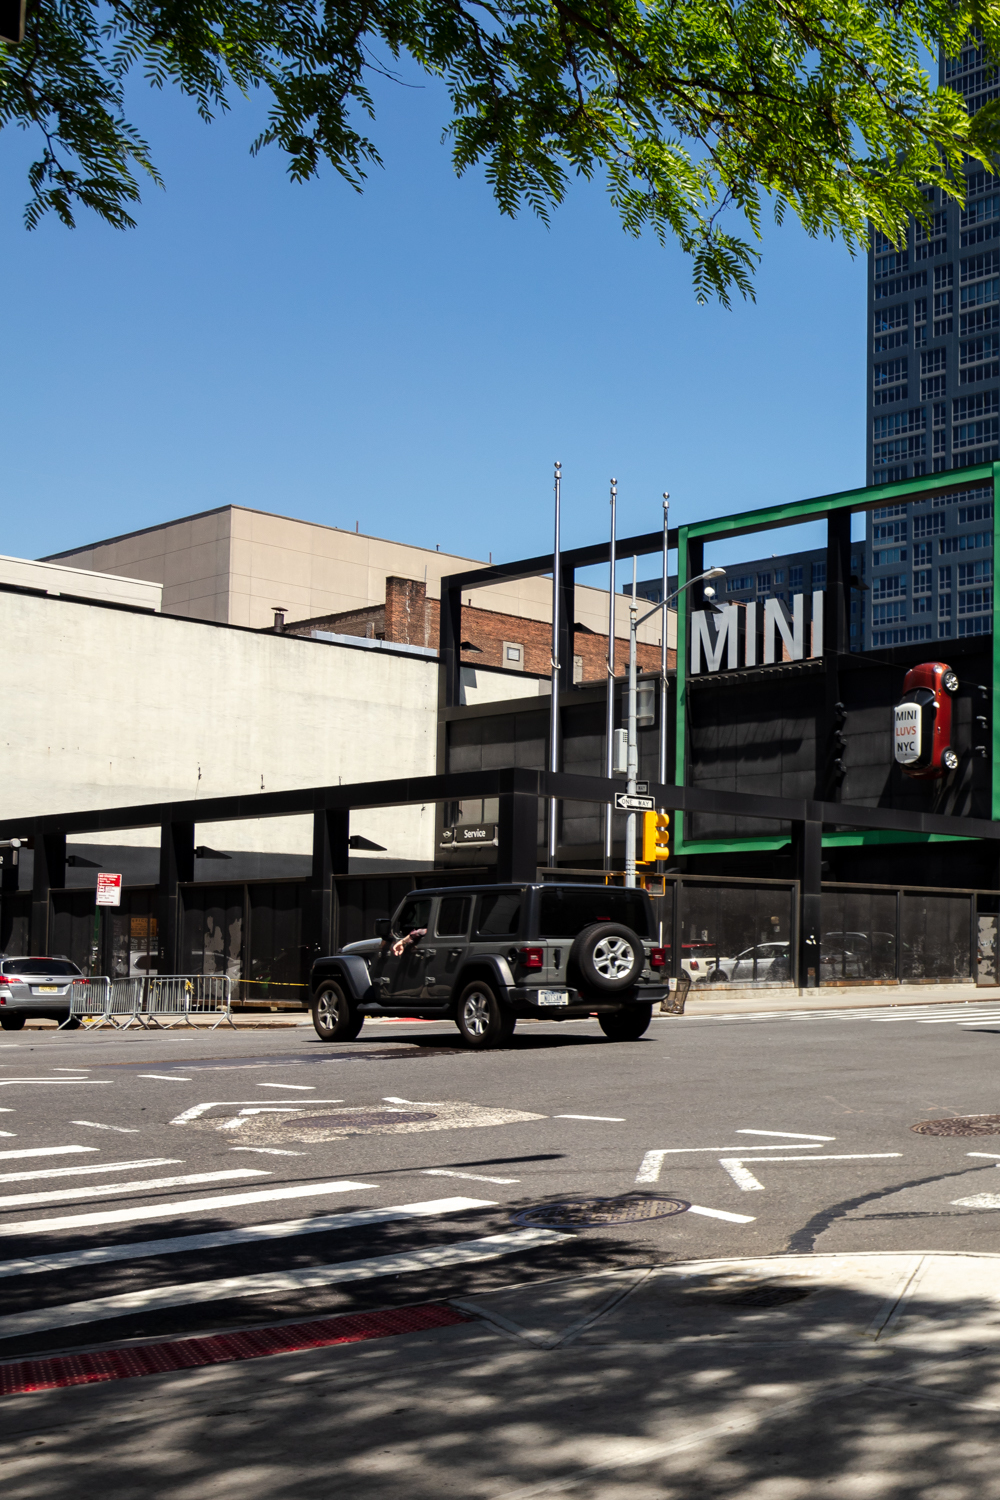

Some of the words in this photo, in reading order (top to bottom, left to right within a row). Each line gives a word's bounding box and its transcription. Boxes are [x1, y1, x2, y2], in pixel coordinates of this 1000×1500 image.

[691, 590, 824, 675] MINI
[896, 710, 917, 721] MINI
[896, 726, 917, 736] LUVS
[897, 741, 915, 752] NYC
[621, 798, 633, 806] ONE
[463, 828, 486, 839] Service
